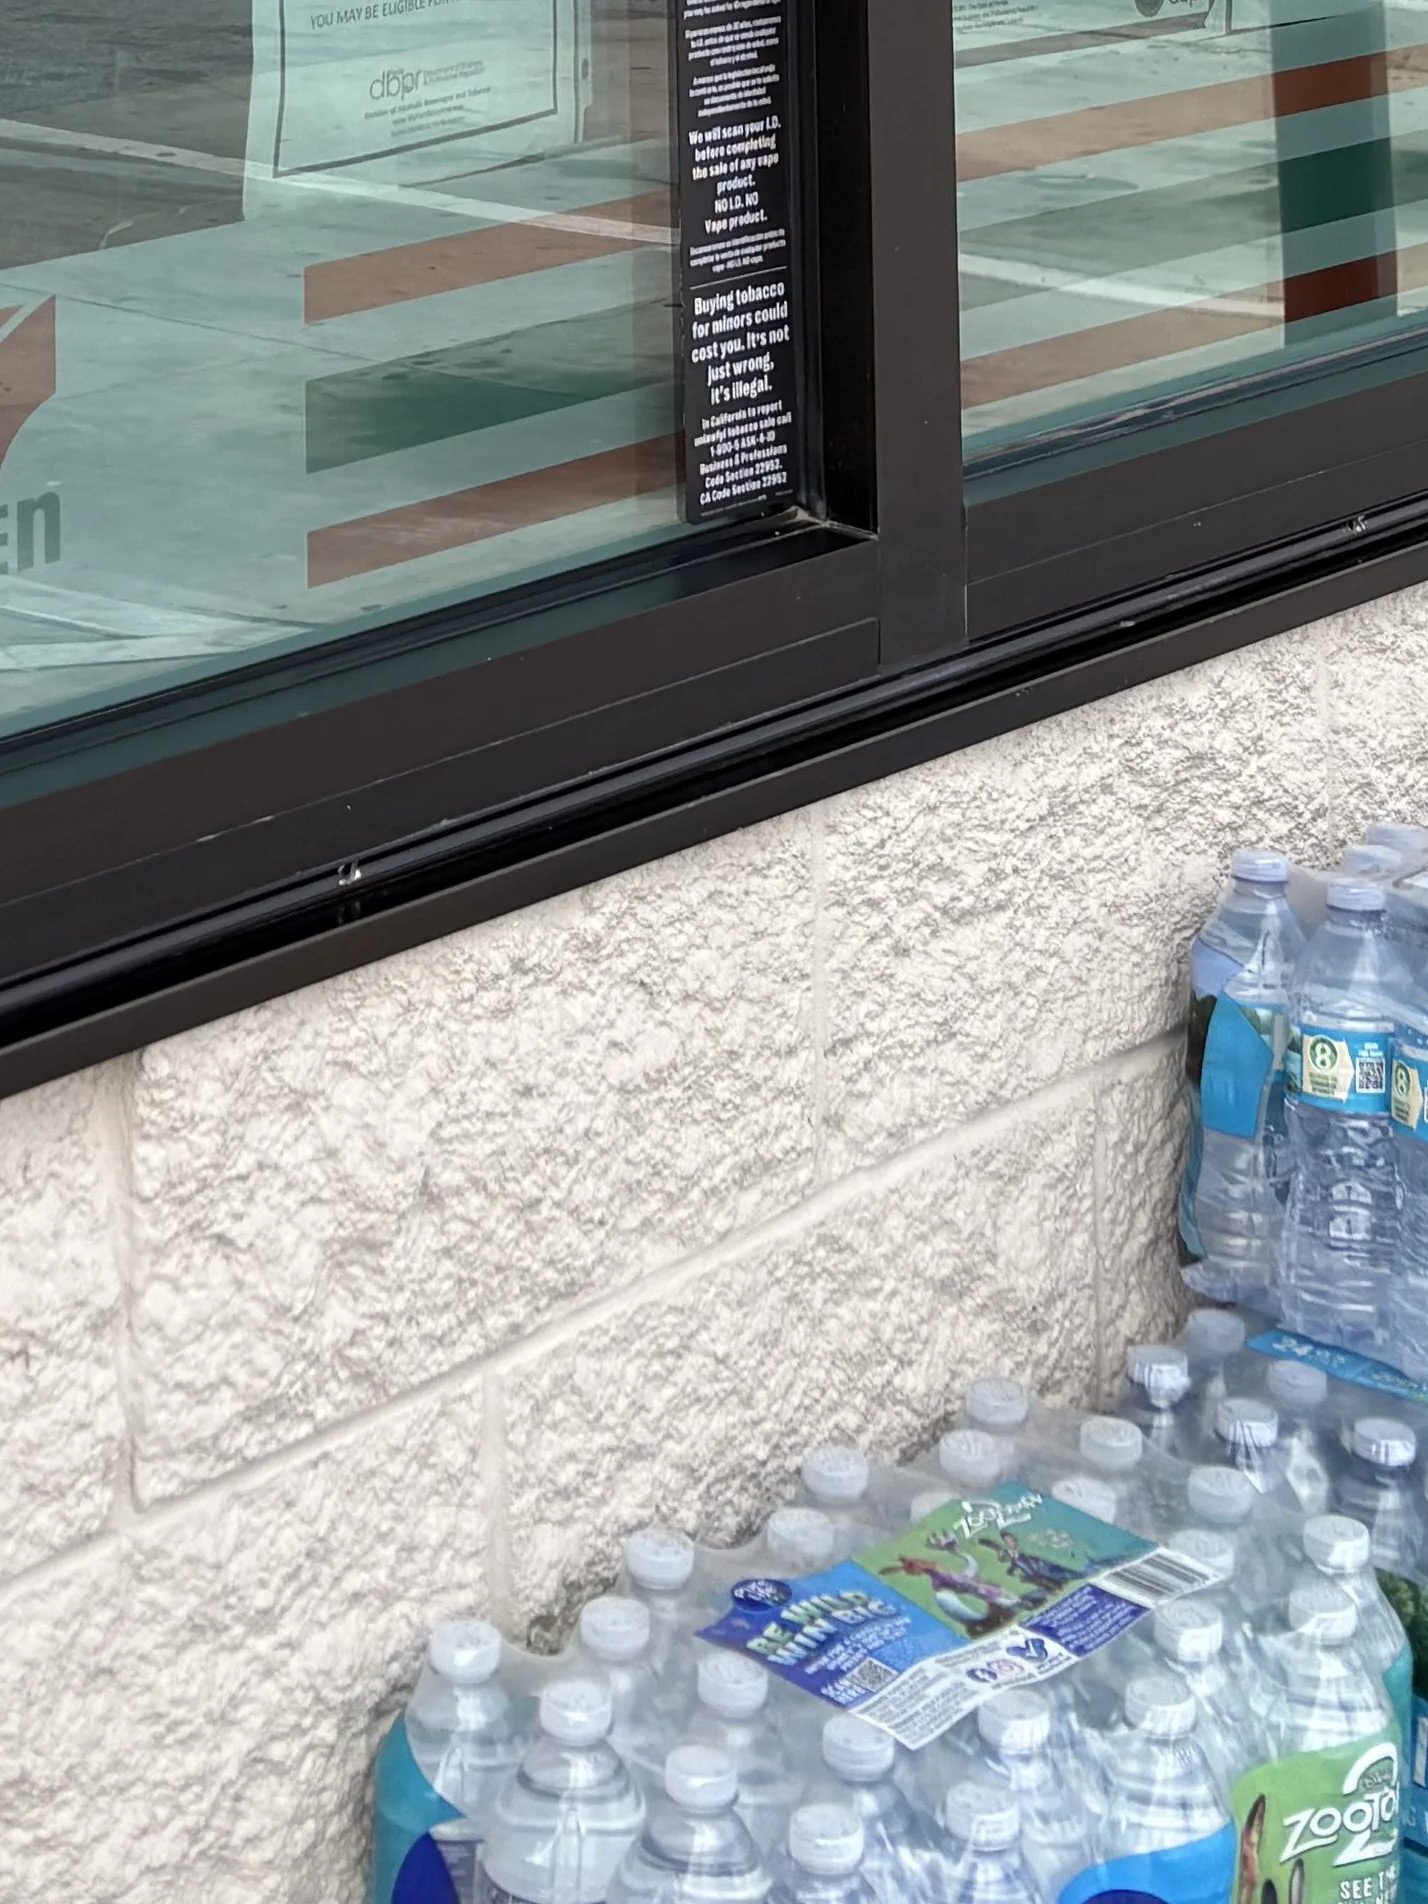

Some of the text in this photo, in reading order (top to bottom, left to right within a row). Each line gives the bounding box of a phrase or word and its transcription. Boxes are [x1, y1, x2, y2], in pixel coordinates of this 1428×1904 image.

[716, 174, 756, 196] product.
[693, 281, 786, 317] Buying tobacco
[691, 300, 789, 340] for minors could
[691, 324, 791, 364] cost you. It's not
[706, 352, 776, 387] just wrong,
[732, 374, 773, 400] illegal.
[781, 1590, 869, 1626] WILD
[768, 1616, 838, 1666] WIN
[1340, 1877, 1373, 1900] SEE
